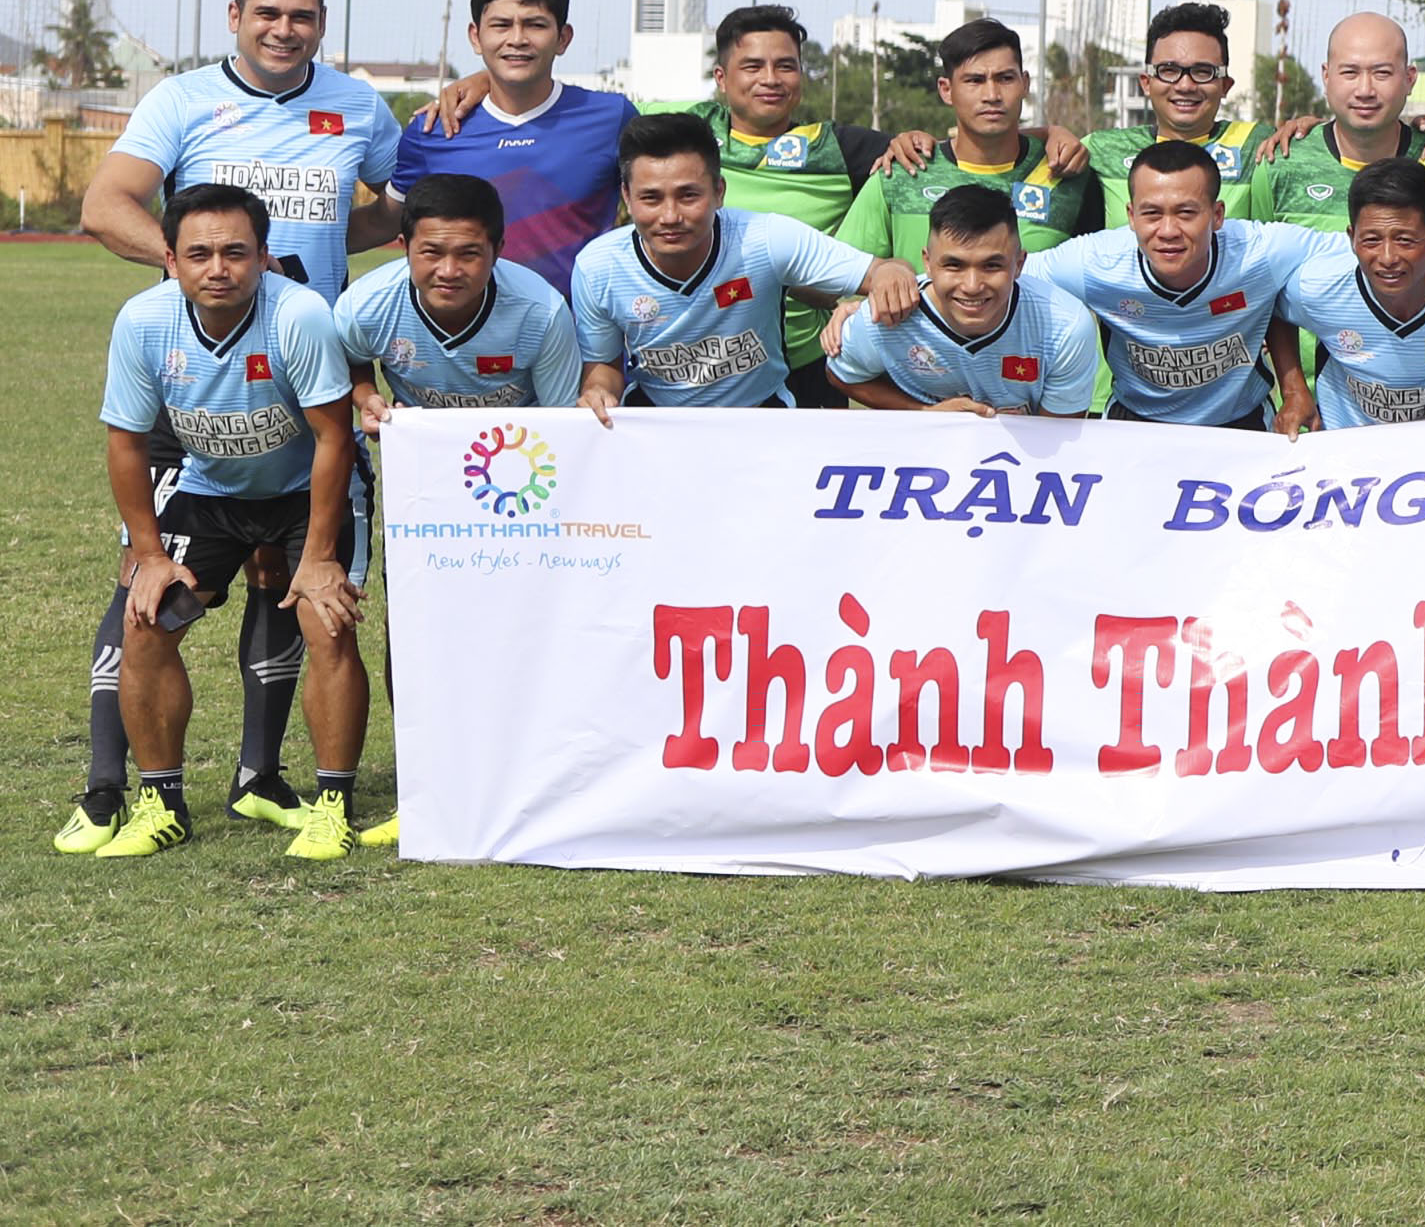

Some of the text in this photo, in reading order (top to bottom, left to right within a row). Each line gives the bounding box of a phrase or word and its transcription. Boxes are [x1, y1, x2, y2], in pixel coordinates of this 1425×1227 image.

[215, 160, 337, 193] HOÀNG SA
[309, 197, 337, 221] SA
[640, 331, 759, 366] HOÀNG SA
[736, 347, 768, 371] SA
[1128, 334, 1244, 368] HOÀNG SA
[169, 405, 288, 435] HOÀNG SA
[265, 423, 299, 449] SA
[814, 451, 1103, 538] TRẬN
[471, 548, 520, 575] styles
[579, 552, 622, 576] ways
[653, 592, 1054, 778] Thành
